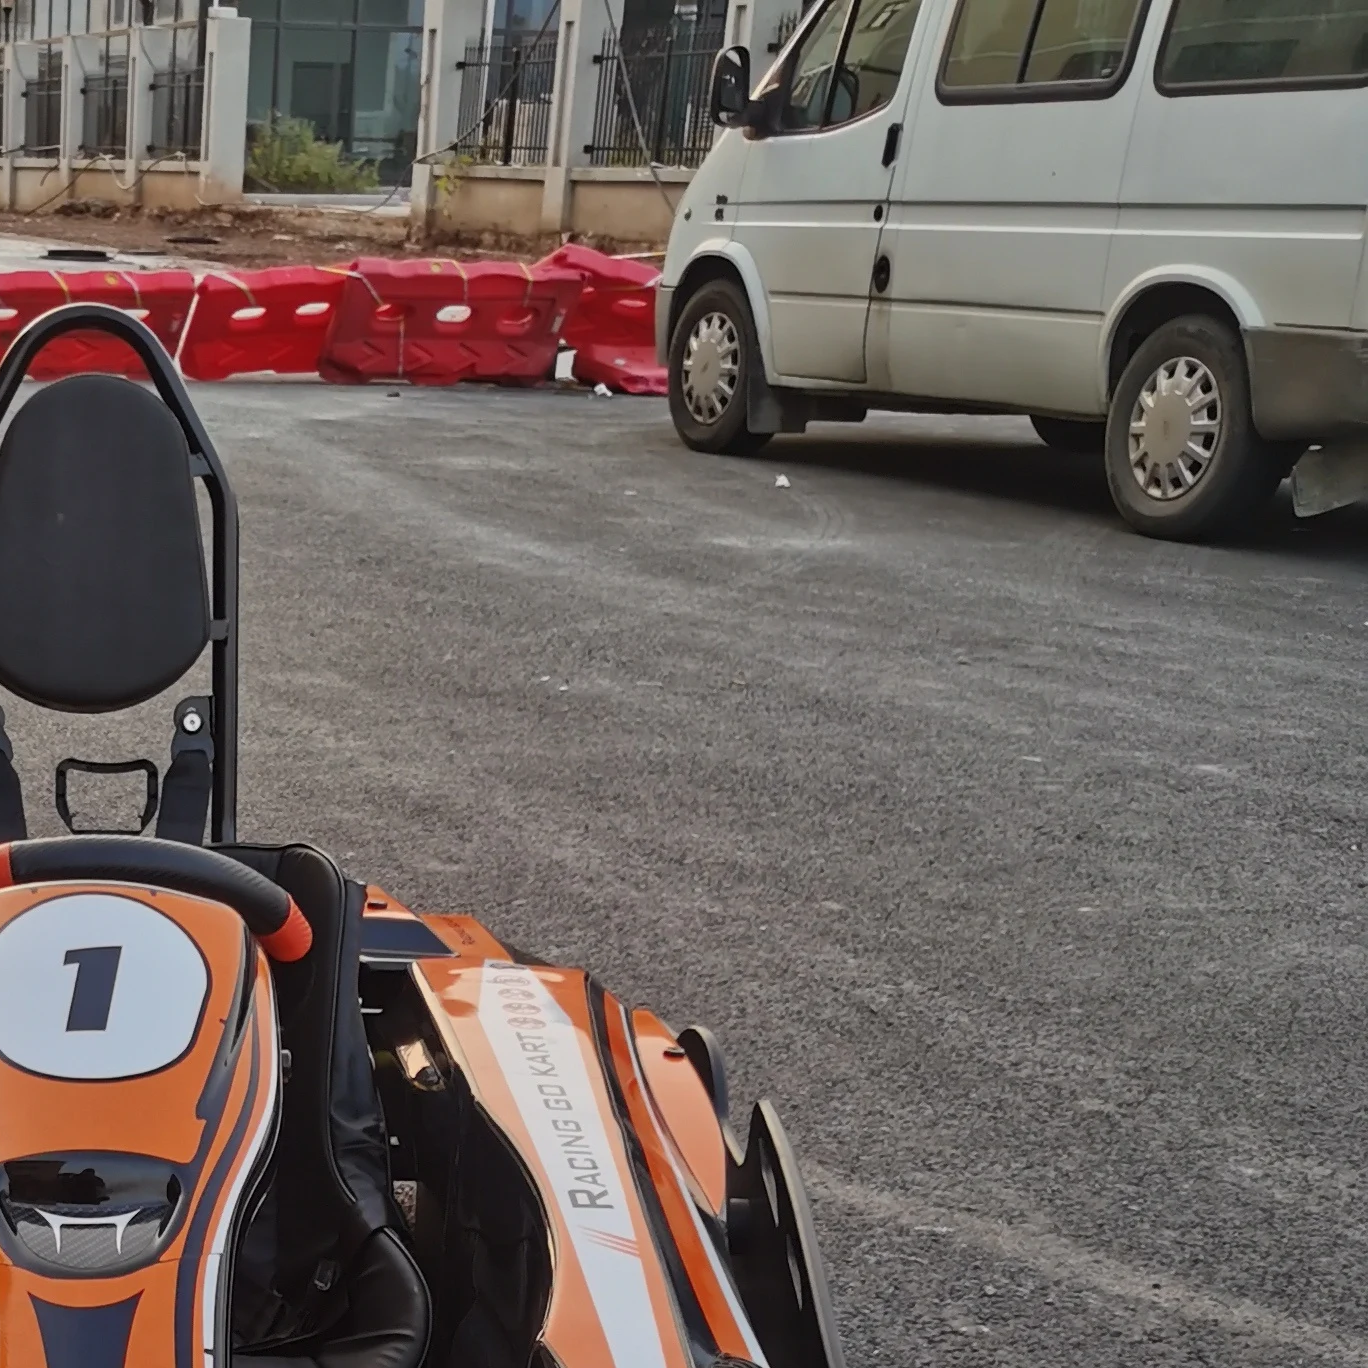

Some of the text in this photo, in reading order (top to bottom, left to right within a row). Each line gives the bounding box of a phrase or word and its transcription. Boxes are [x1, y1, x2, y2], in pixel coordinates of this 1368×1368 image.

[63, 946, 122, 1031] 1
[516, 1032, 558, 1077] KART
[537, 1084, 573, 1111] GO
